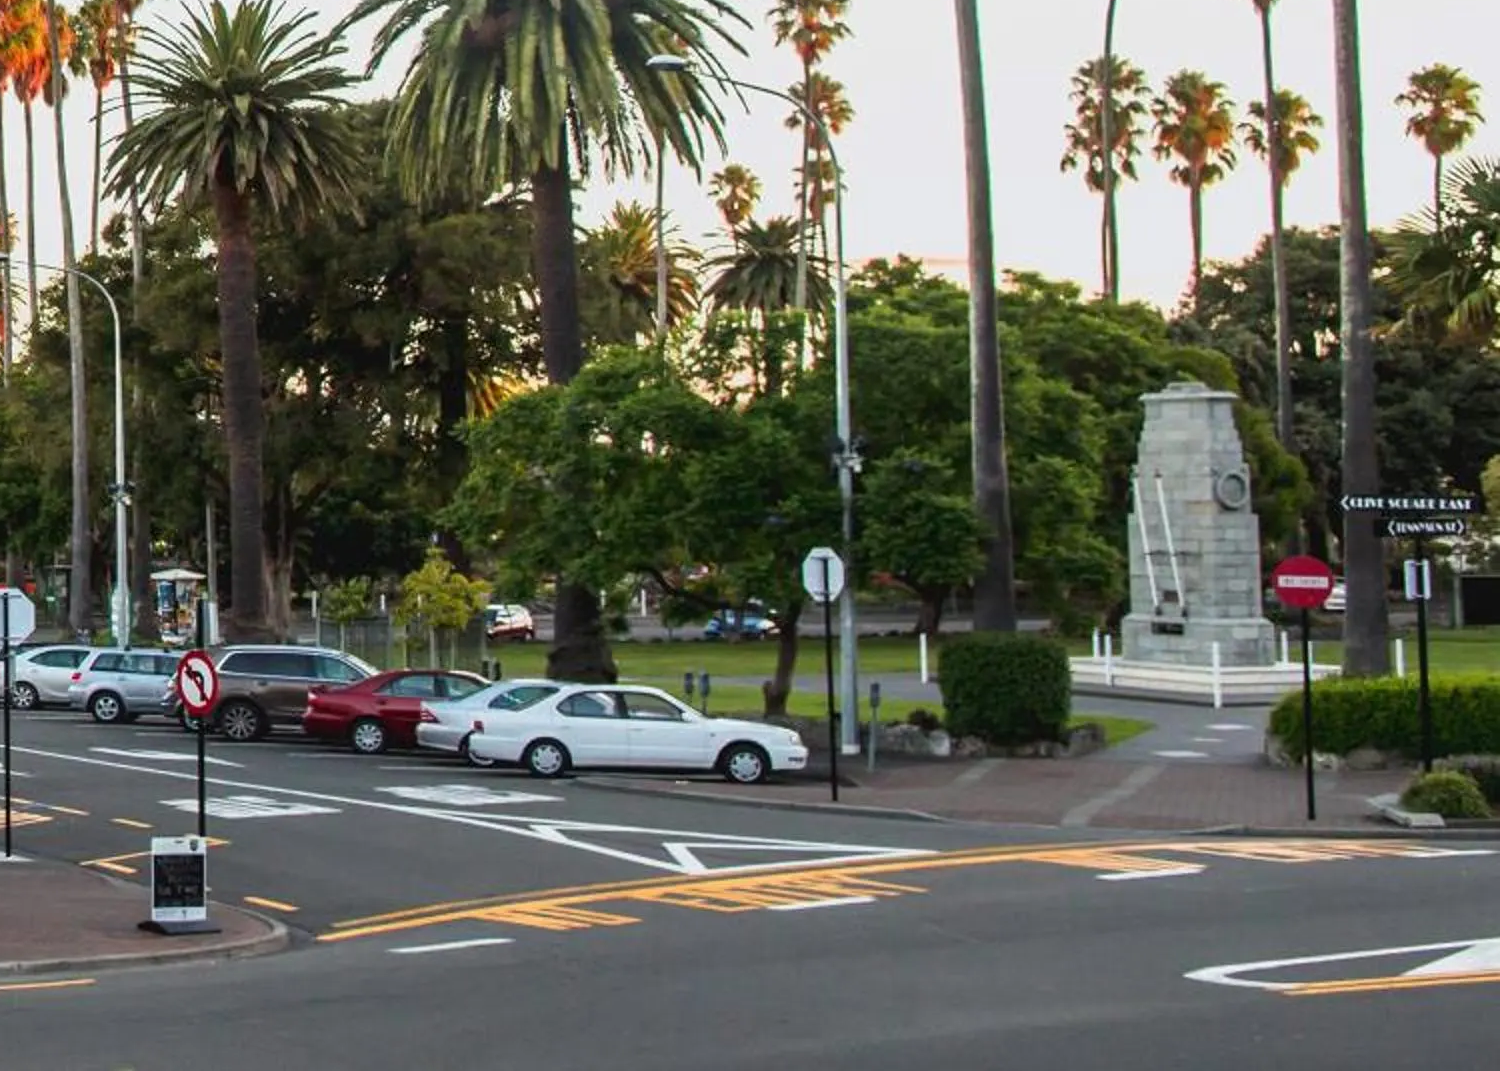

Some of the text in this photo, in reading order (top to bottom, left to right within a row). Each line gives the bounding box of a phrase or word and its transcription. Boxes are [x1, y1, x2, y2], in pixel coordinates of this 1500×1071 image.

[1349, 498, 1472, 510] CLIVE SQUARE EAST
